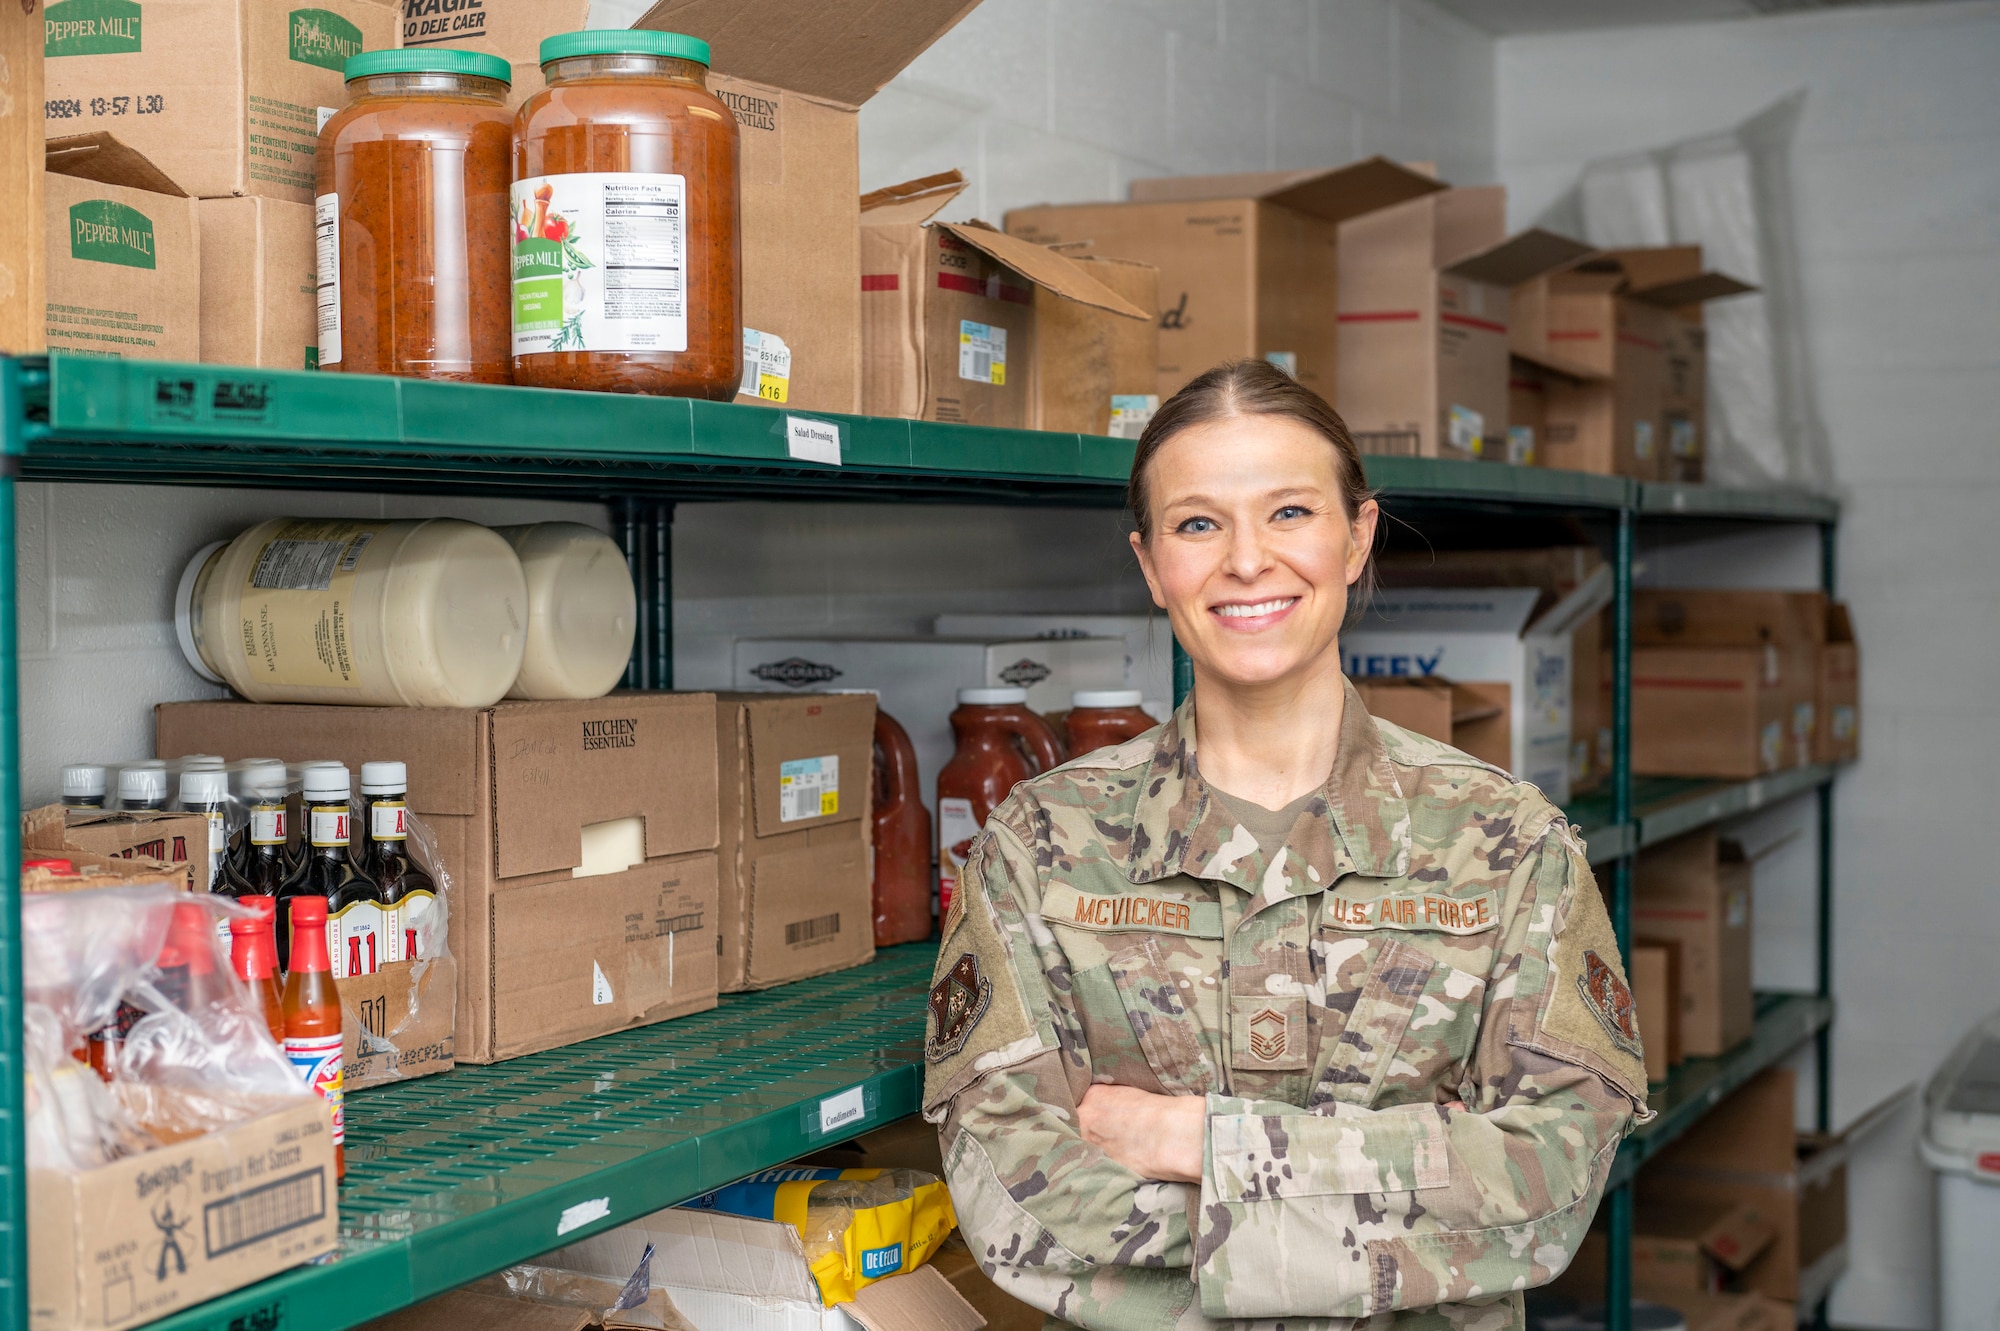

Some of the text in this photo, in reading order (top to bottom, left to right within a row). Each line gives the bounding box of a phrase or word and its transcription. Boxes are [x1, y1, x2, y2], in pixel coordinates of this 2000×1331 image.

[45, 20, 96, 44] PEPPER
[420, 18, 450, 36] DEJE
[453, 12, 486, 30] CAER
[294, 23, 332, 50] PEPPER
[90, 96, 130, 116] 13:57
[137, 94, 164, 114] L30
[716, 89, 774, 116] KITCHEN
[734, 110, 775, 131] ENTIALS
[250, 134, 261, 144] NET
[262, 136, 287, 150] CONTENTS
[666, 208, 678, 216] 80
[76, 218, 120, 246] PEPPER
[514, 254, 535, 273] PEPPER
[760, 351, 785, 364] 851411
[794, 426, 833, 444] Salad Dressing
[260, 607, 276, 672] MAYONNAISE
[1340, 646, 1444, 676] IFFY
[582, 718, 634, 736] KITCHEN
[583, 734, 635, 750] ESSENTIALS
[1074, 896, 1190, 930] MCVICKER
[1334, 896, 1489, 928] U.S. AIR FORCE
[348, 931, 376, 977] A1
[598, 992, 602, 1002] 6
[826, 1107, 857, 1126] Condiments
[867, 1248, 898, 1270] DE CECCO
